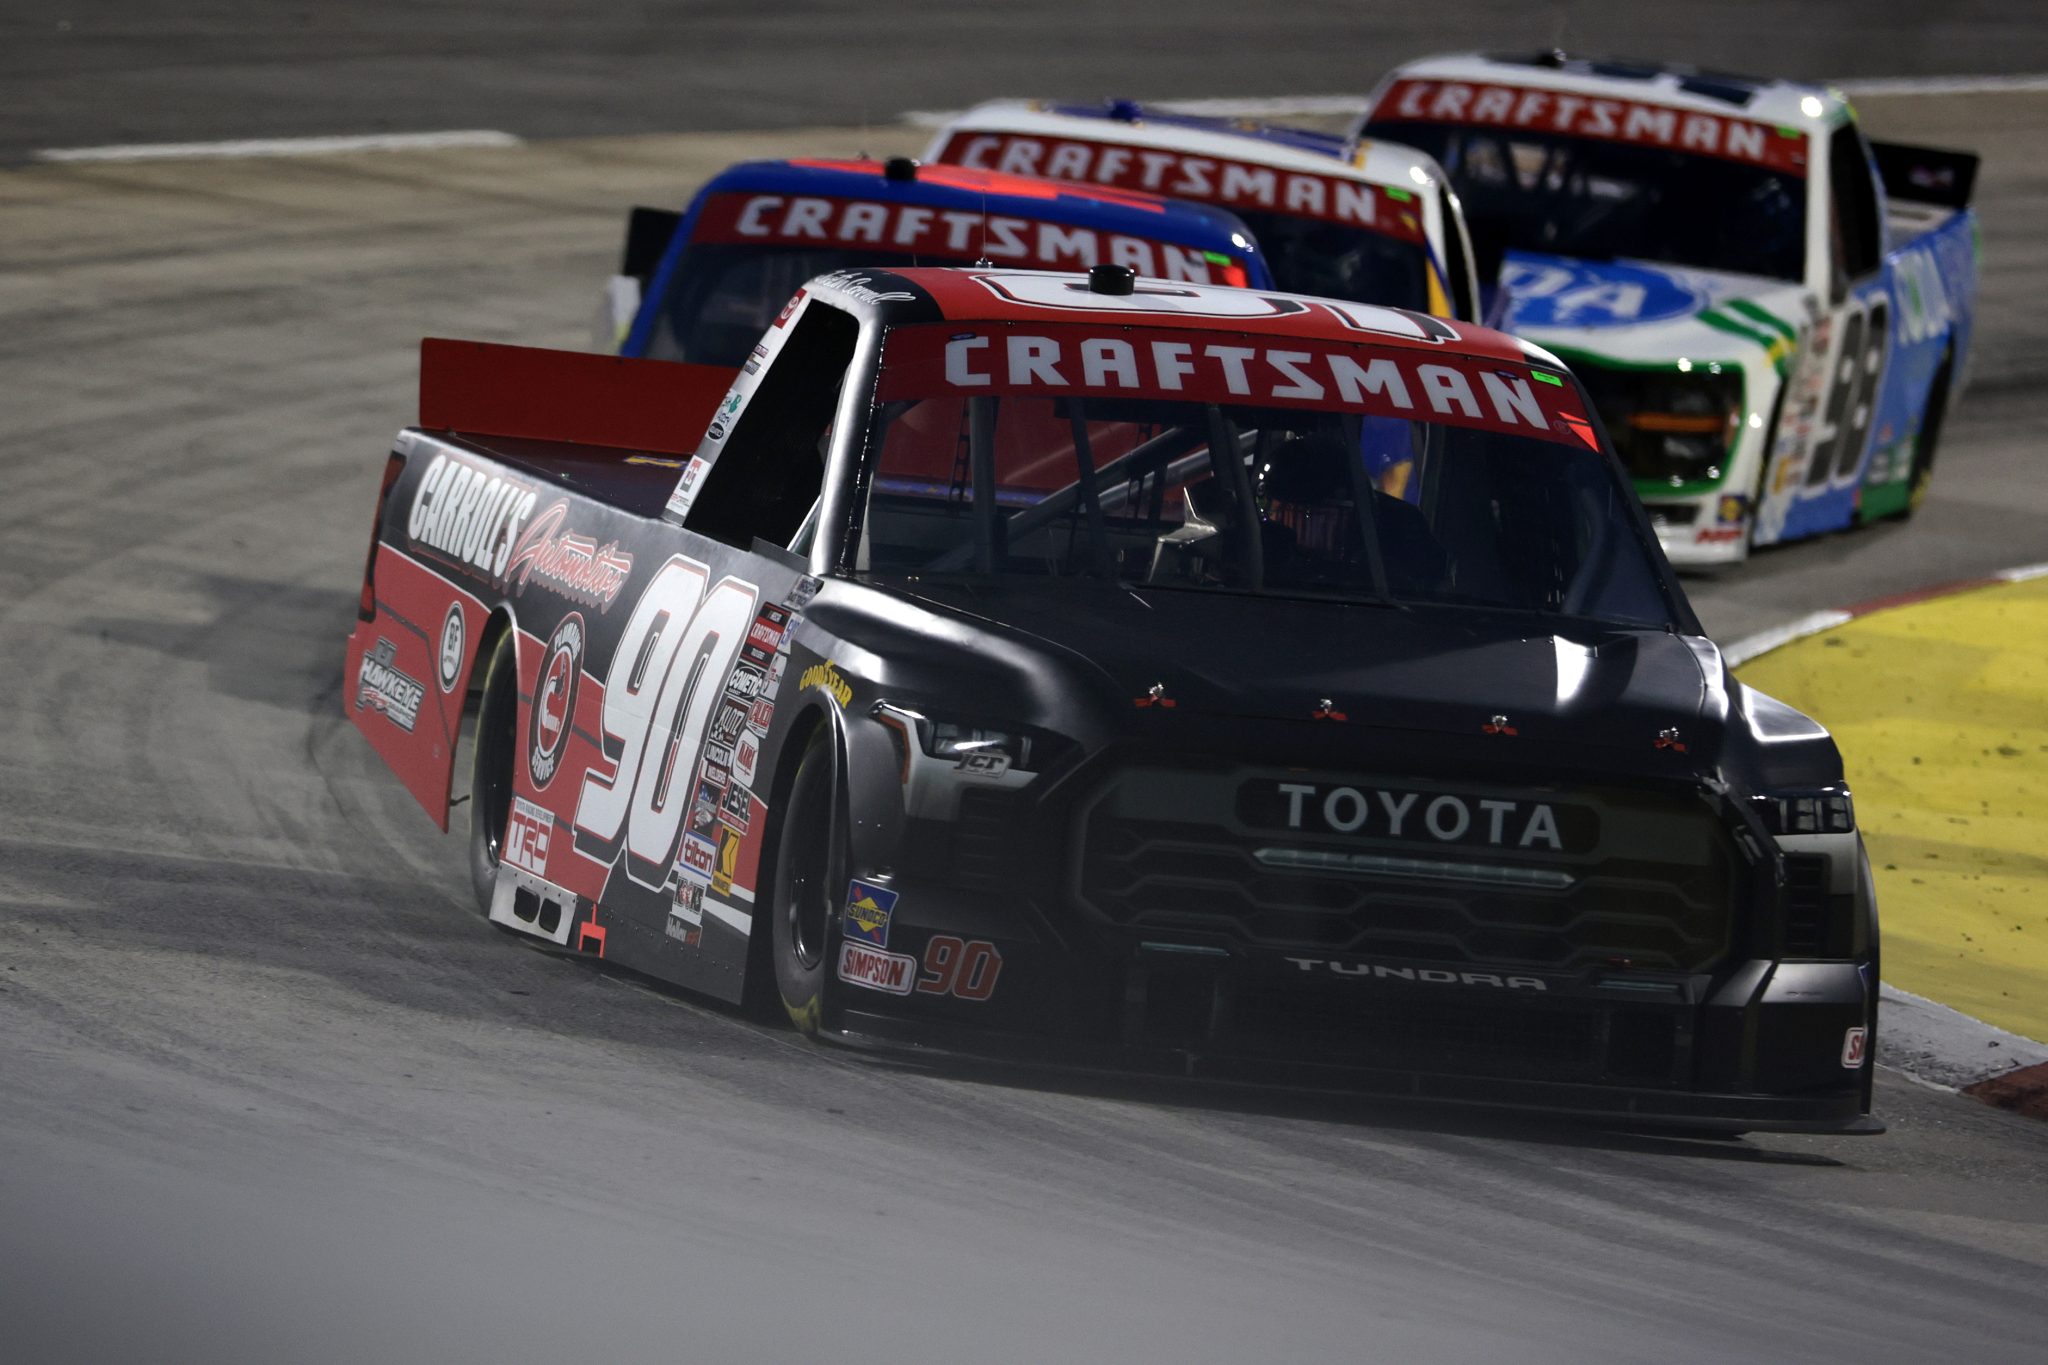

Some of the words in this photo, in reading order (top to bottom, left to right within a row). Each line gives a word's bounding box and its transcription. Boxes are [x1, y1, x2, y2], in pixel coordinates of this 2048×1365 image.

[1399, 81, 1767, 159] CRAFTSMAN
[960, 134, 1377, 225] CRAFTSMAN
[736, 195, 1211, 285] CRAFTSMAN
[944, 334, 1549, 430] CRAFTSMAN
[408, 454, 537, 578] CARROLL'S
[505, 499, 633, 604] Automotive
[751, 622, 782, 648] CRAFTSMAN
[361, 656, 423, 711] HAWKEYE
[728, 669, 763, 697] COMETIC
[799, 658, 853, 709] GOODYEAR
[575, 554, 760, 885] 90
[718, 704, 747, 736] KLOTZ
[513, 811, 550, 869] TRD
[1277, 782, 1564, 850] TOYOTA
[685, 838, 713, 873] tilton
[848, 902, 888, 926] SUNOCO
[843, 948, 906, 987] SIMPSON
[916, 935, 1003, 1001] 90
[1284, 956, 1548, 991] TUNDRA
